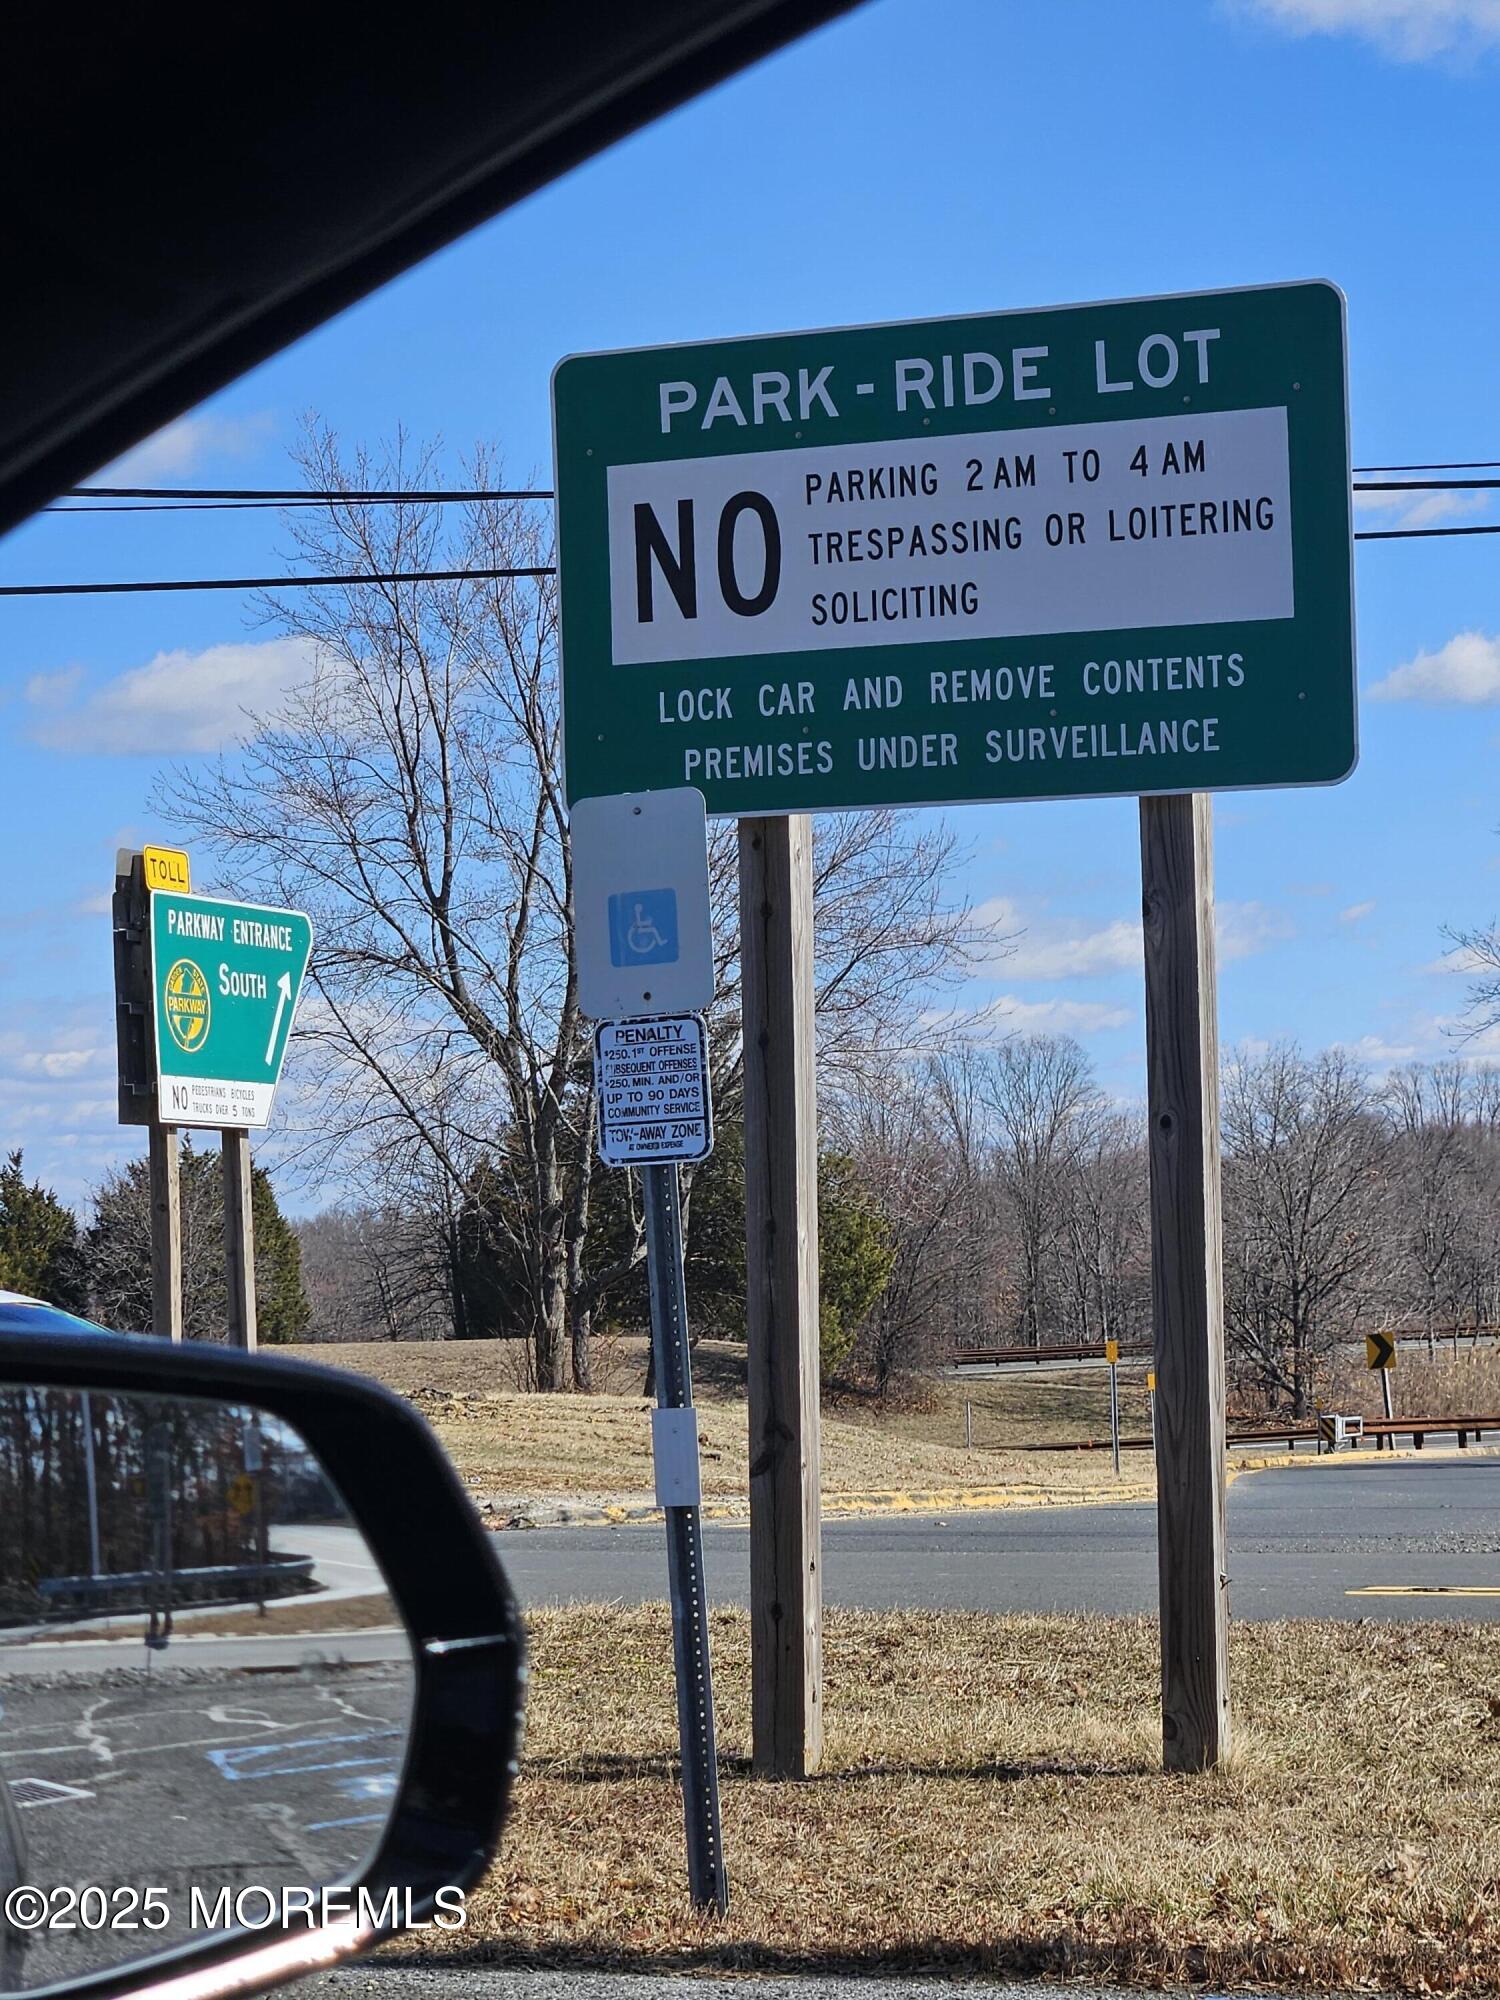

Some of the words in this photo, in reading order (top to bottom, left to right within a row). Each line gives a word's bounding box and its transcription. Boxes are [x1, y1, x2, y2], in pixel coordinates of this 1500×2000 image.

[659, 366, 839, 433] PARK
[895, 345, 1051, 412] RIDE
[1095, 328, 1221, 394] LOT
[806, 462, 938, 505] PARKING
[1062, 448, 1100, 483] TO
[809, 516, 1022, 564] TRESPASSING
[1045, 512, 1086, 548] OR
[1109, 496, 1275, 542] LOITERING
[633, 489, 782, 624] NO
[811, 581, 979, 626] SOLICITING
[659, 686, 733, 724] LOCK
[758, 681, 816, 717] CAR
[843, 675, 902, 710] AND
[930, 664, 1055, 705] REMOVE
[1083, 653, 1245, 696] CONTENTS
[684, 740, 834, 781] PREMISES
[858, 732, 958, 771] UNDER
[985, 717, 1220, 764] SURVEILLANCE
[150, 857, 186, 884] TOLL
[168, 909, 225, 942] PARKWAY
[233, 919, 293, 952] ENTRANCE
[218, 962, 267, 999] SOUTH
[168, 996, 207, 1015] PARKWAY
[615, 1024, 683, 1043] PENALTY
[649, 1042, 697, 1057] OFFENSE
[658, 1057, 698, 1071] OFFENSES
[658, 1072, 700, 1085] AND/OR
[172, 1084, 188, 1110] NO
[192, 1084, 226, 1099] PEDESTRIANS
[231, 1088, 255, 1101] BICYCLES
[607, 1093, 623, 1105] UP
[627, 1091, 643, 1103] TO
[648, 1089, 665, 1101] 90
[669, 1086, 699, 1099] DAYS
[192, 1101, 213, 1114] TRUCKS
[215, 1104, 228, 1115] OVER
[232, 1104, 238, 1117] 5
[242, 1106, 255, 1118] TONS
[608, 1105, 661, 1119] COMMUNITY
[663, 1101, 701, 1115] SERVICE
[609, 1125, 667, 1143] TOW-AWAY
[671, 1122, 702, 1139] ZONE
